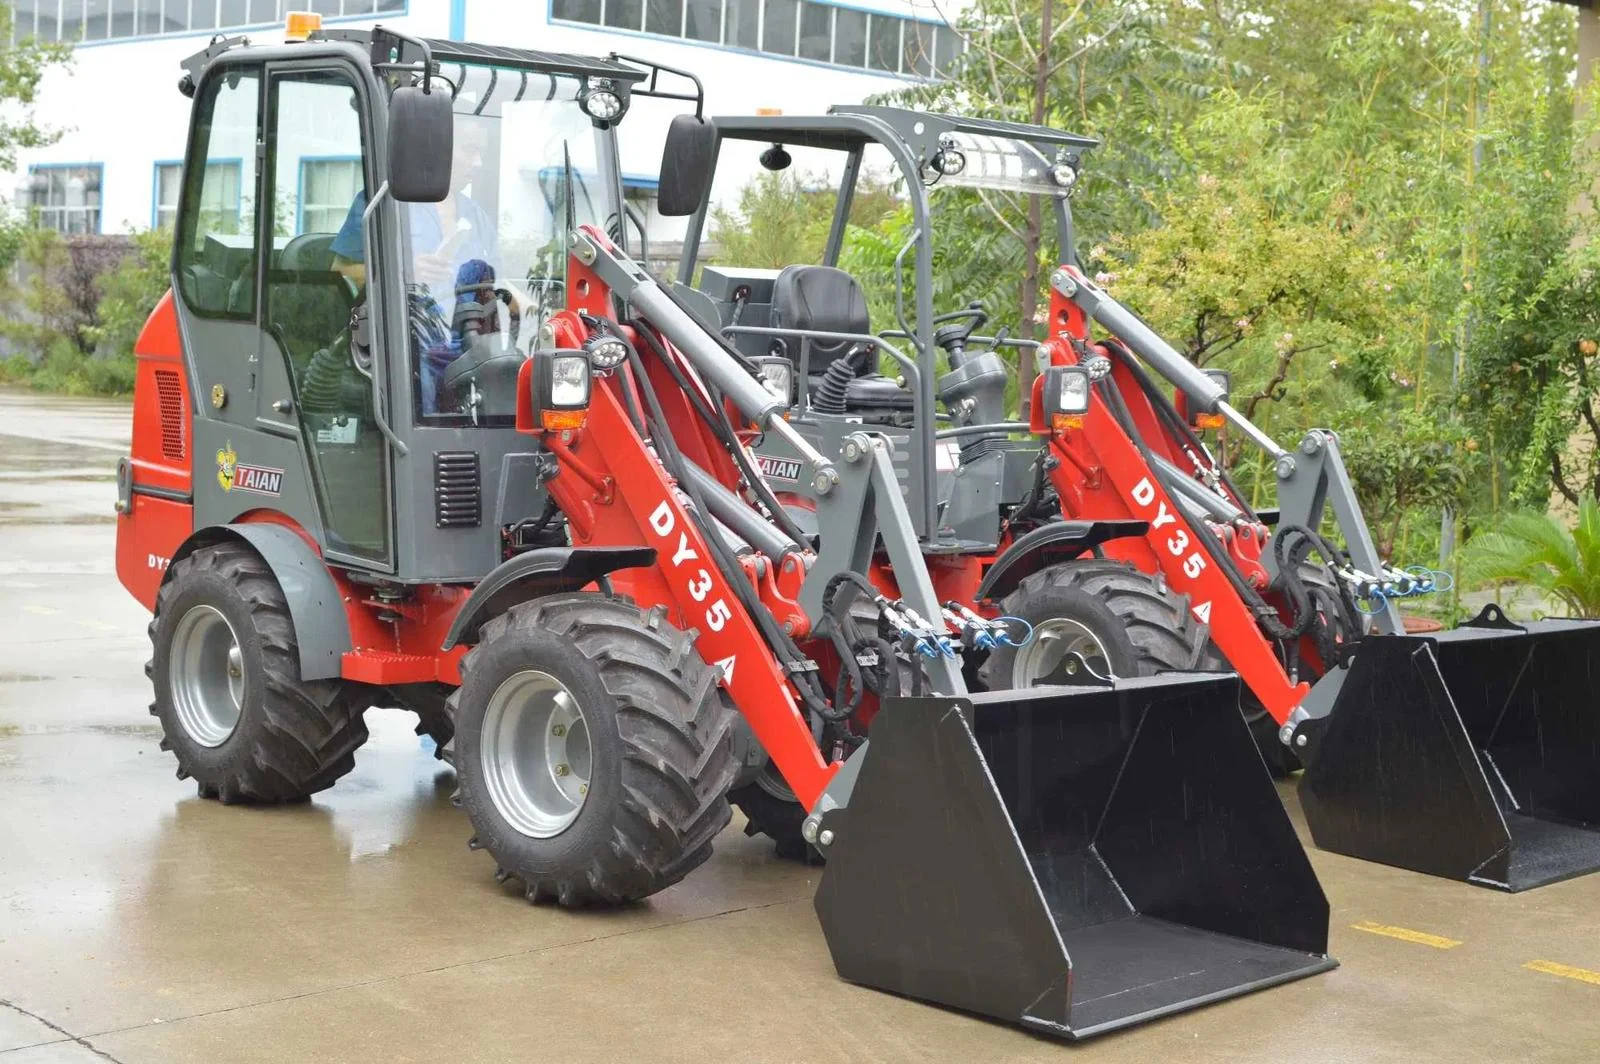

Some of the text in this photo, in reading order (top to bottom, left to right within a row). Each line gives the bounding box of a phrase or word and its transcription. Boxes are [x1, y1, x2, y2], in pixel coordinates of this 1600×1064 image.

[238, 468, 281, 492] TAIAN
[759, 459, 799, 479] AIAN
[1131, 477, 1207, 579] DY35
[649, 500, 733, 632] DY35
